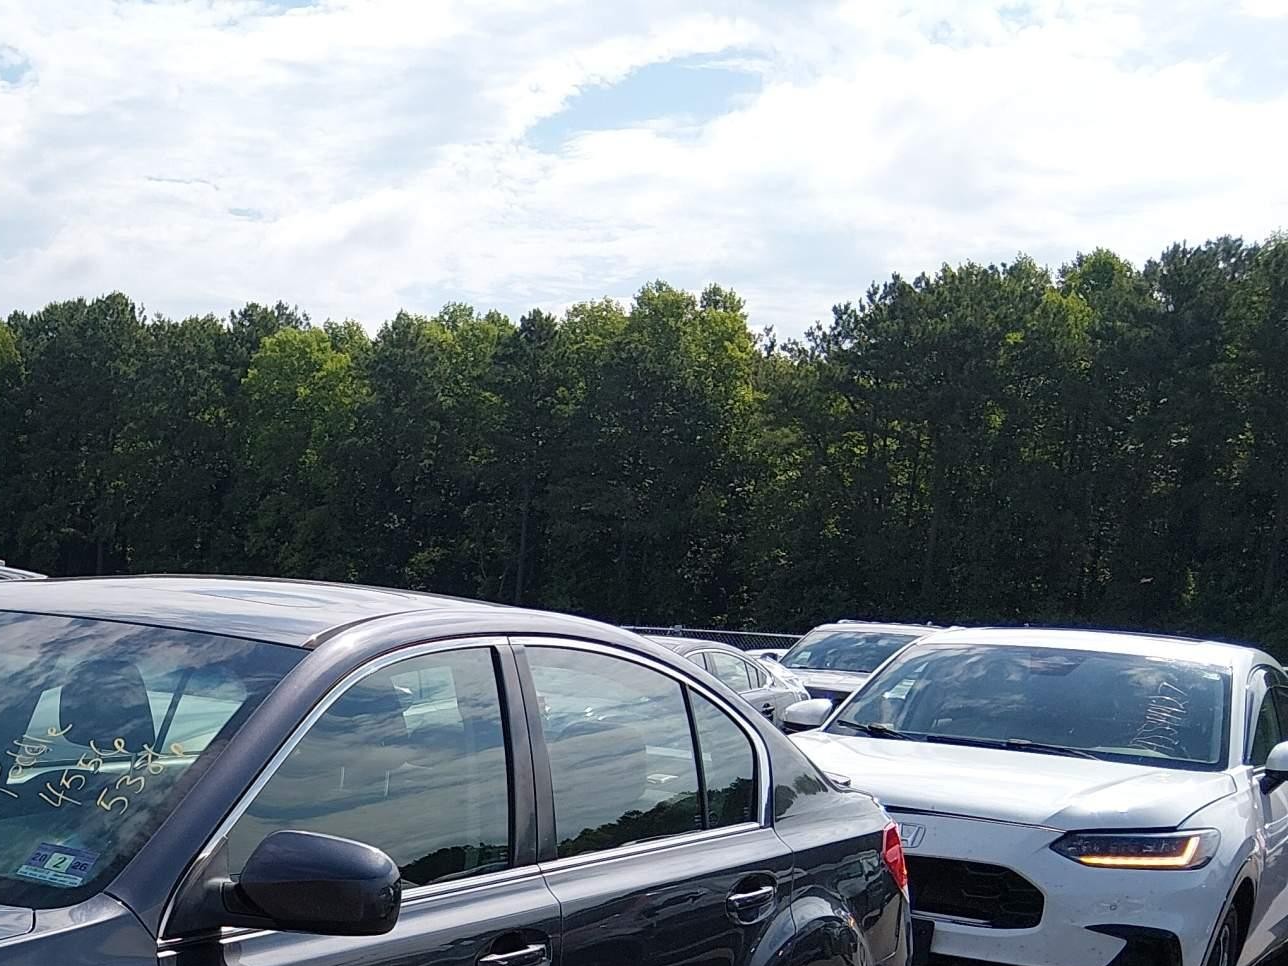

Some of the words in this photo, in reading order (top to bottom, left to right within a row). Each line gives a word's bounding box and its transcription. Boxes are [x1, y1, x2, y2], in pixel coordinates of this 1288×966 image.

[39, 738, 130, 808] 4556
[31, 852, 48, 863] 20
[52, 856, 68, 869] 2
[71, 861, 89, 872] 26
